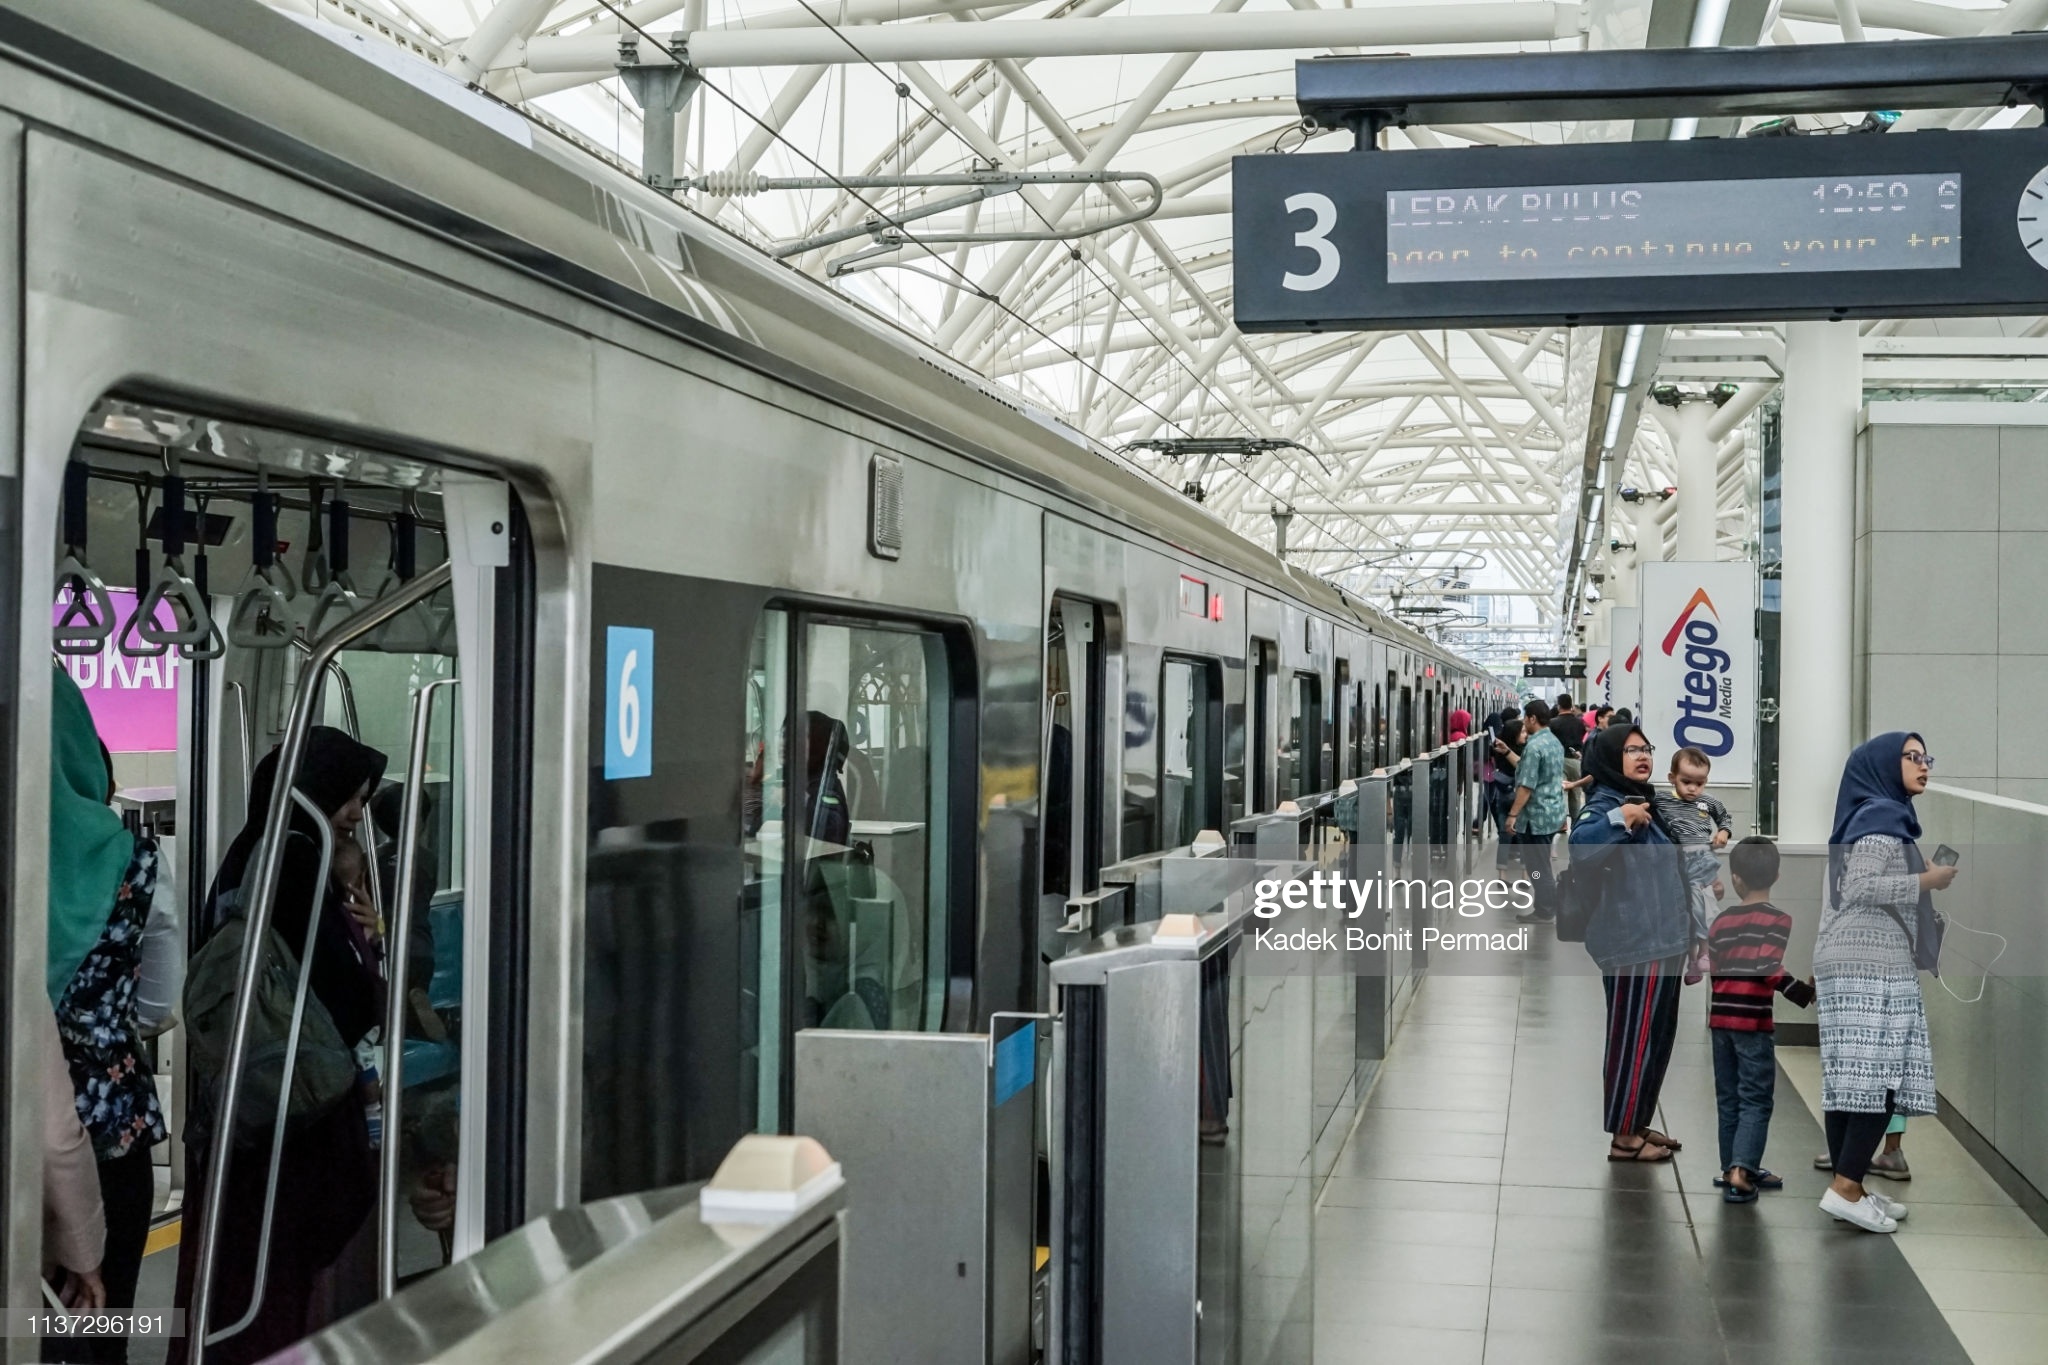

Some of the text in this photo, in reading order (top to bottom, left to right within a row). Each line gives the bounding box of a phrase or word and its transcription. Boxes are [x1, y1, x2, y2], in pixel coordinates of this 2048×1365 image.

[1282, 192, 1341, 291] 3
[619, 649, 640, 757] 6
[1527, 667, 1533, 676] 3
[1673, 620, 1735, 757] Otego
[1719, 677, 1732, 719] Media
